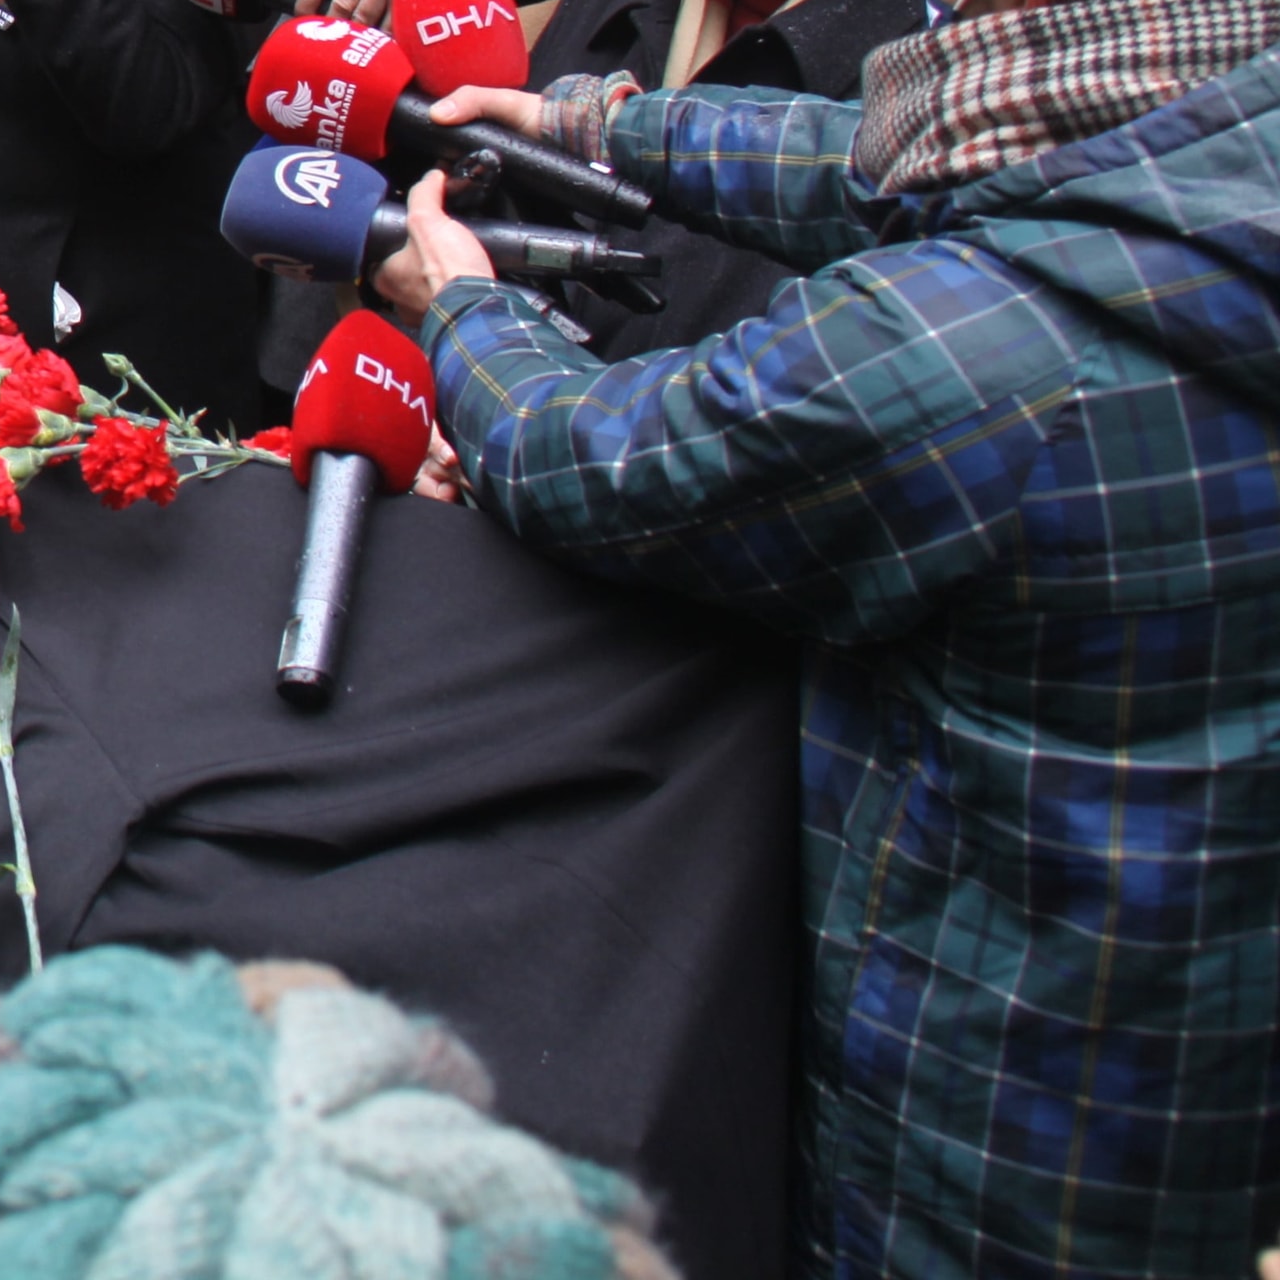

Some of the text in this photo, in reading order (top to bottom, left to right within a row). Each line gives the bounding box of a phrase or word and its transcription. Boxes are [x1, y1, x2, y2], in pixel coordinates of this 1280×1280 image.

[342, 27, 386, 65] anka
[416, 0, 515, 46] DHA
[312, 79, 347, 149] anka
[355, 353, 429, 427] DHA
